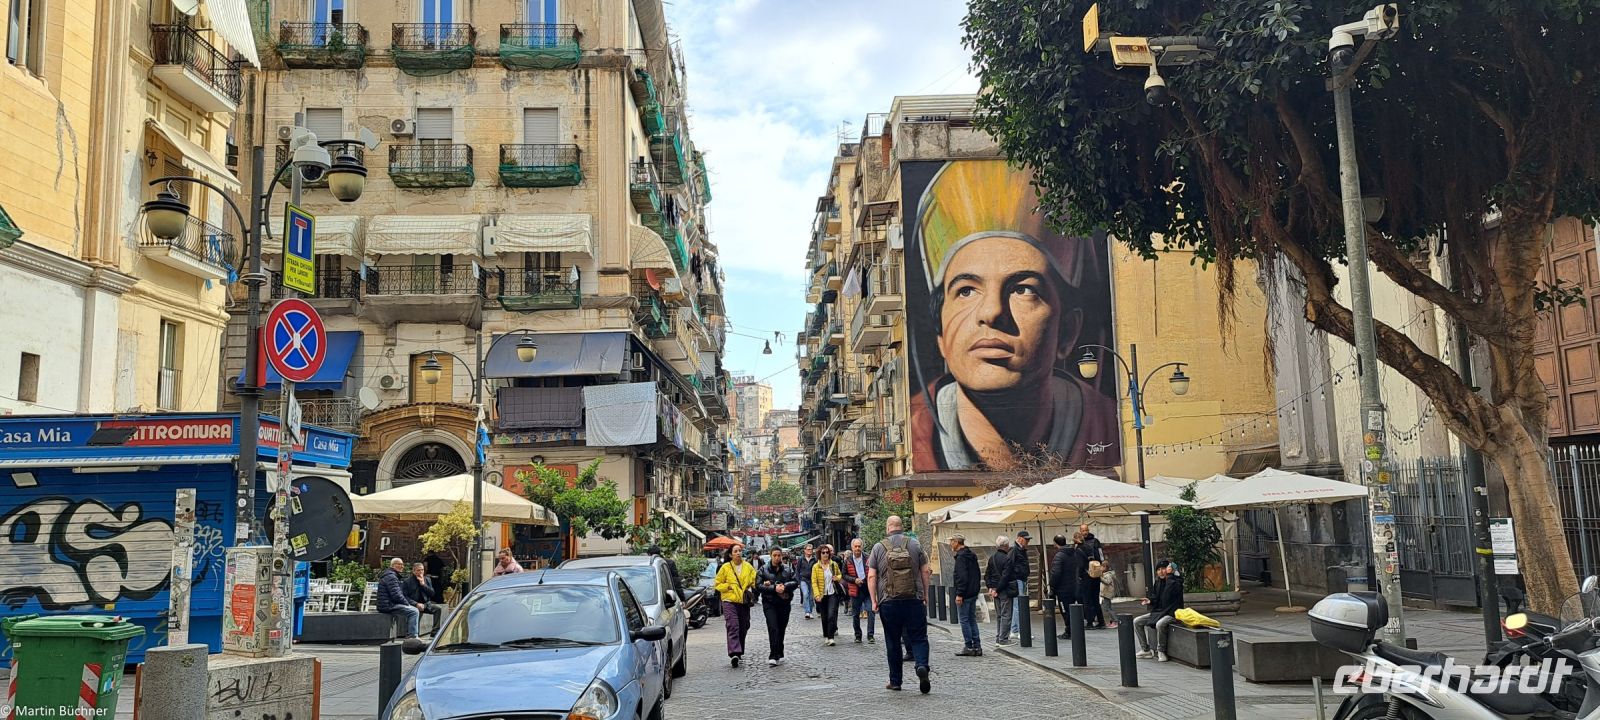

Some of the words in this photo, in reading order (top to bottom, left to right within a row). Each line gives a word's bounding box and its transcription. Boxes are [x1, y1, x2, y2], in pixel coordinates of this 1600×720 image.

[37, 428, 71, 442] Mia
[313, 436, 327, 450] Casa
[328, 439, 339, 452] Mia
